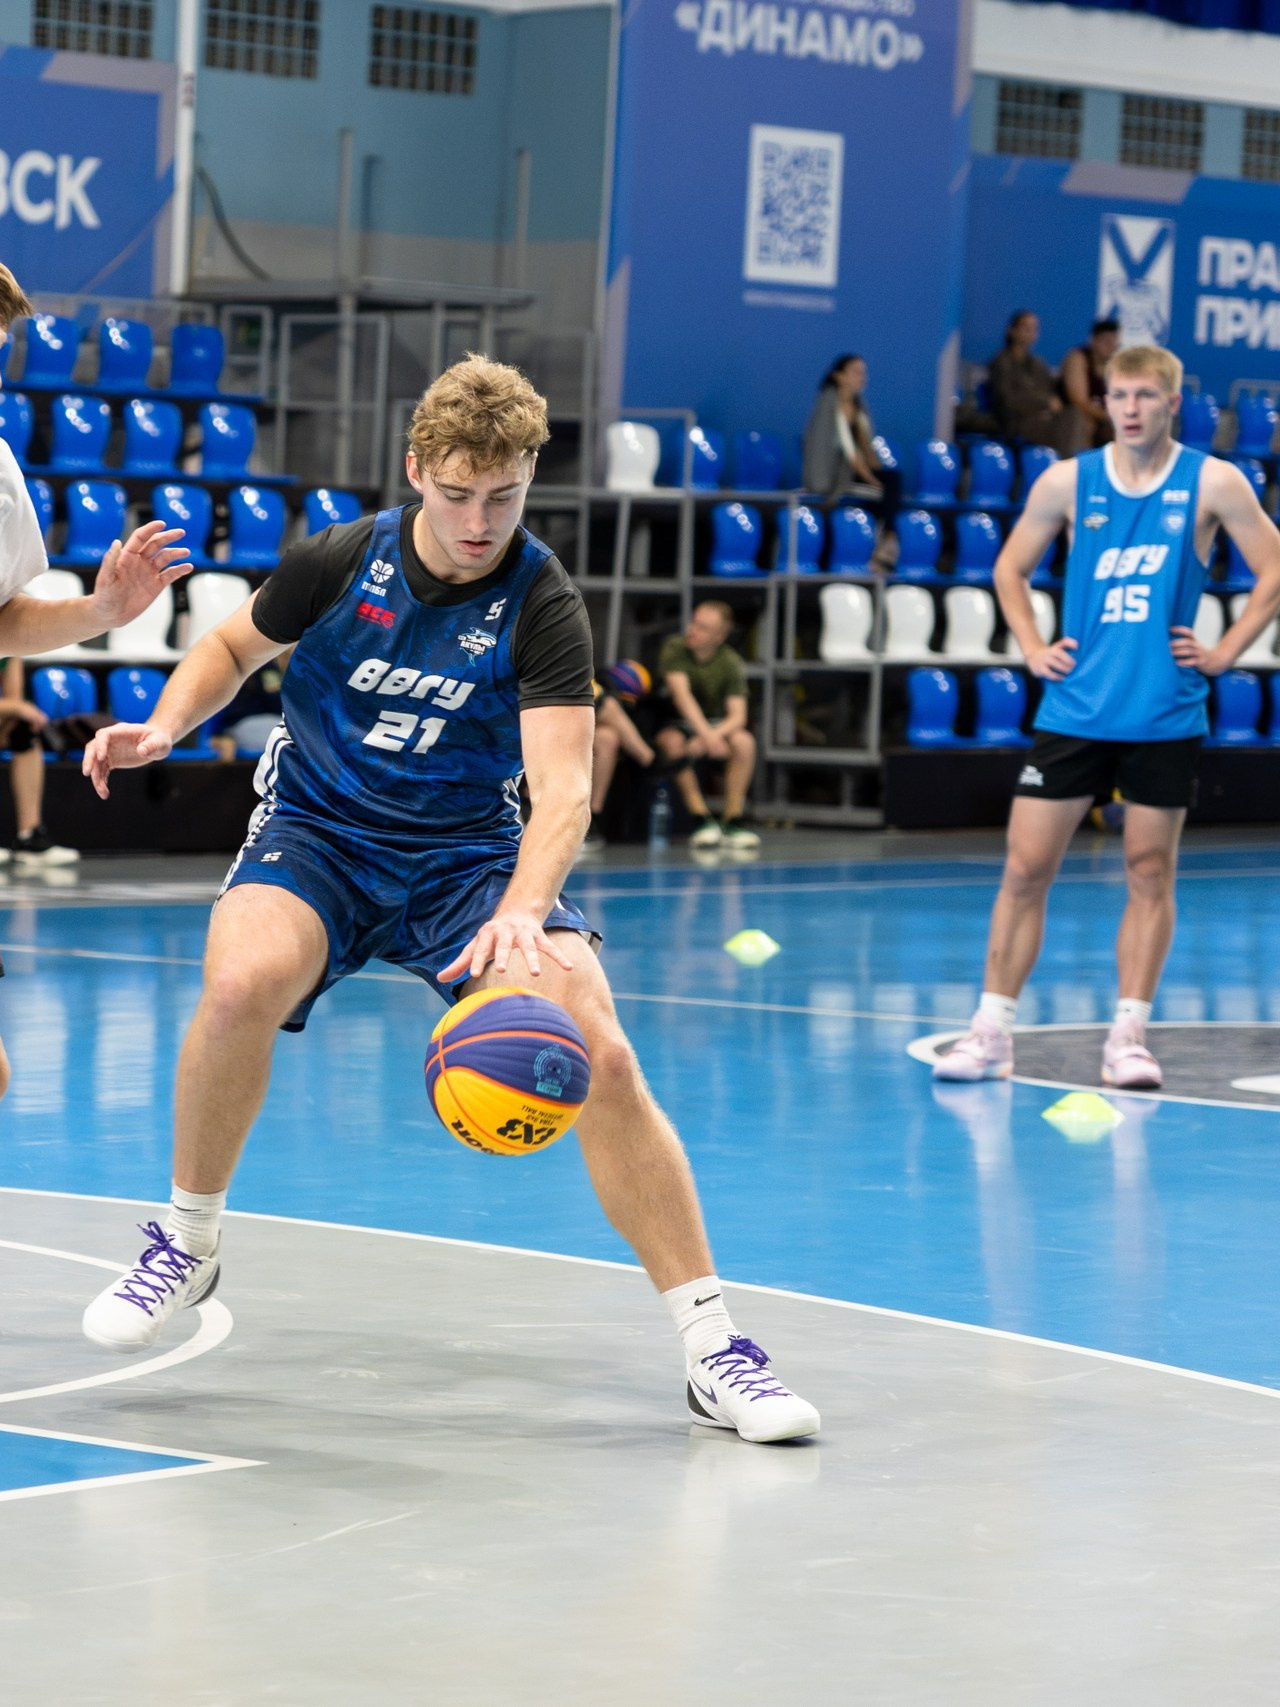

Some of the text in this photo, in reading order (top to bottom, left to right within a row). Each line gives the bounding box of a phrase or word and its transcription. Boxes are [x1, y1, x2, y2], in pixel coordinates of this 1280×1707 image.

[675, 0, 924, 70] «ДИНАМО»
[1100, 584, 1151, 624] 95
[362, 710, 447, 754] 21
[521, 1105, 537, 1115] BALL
